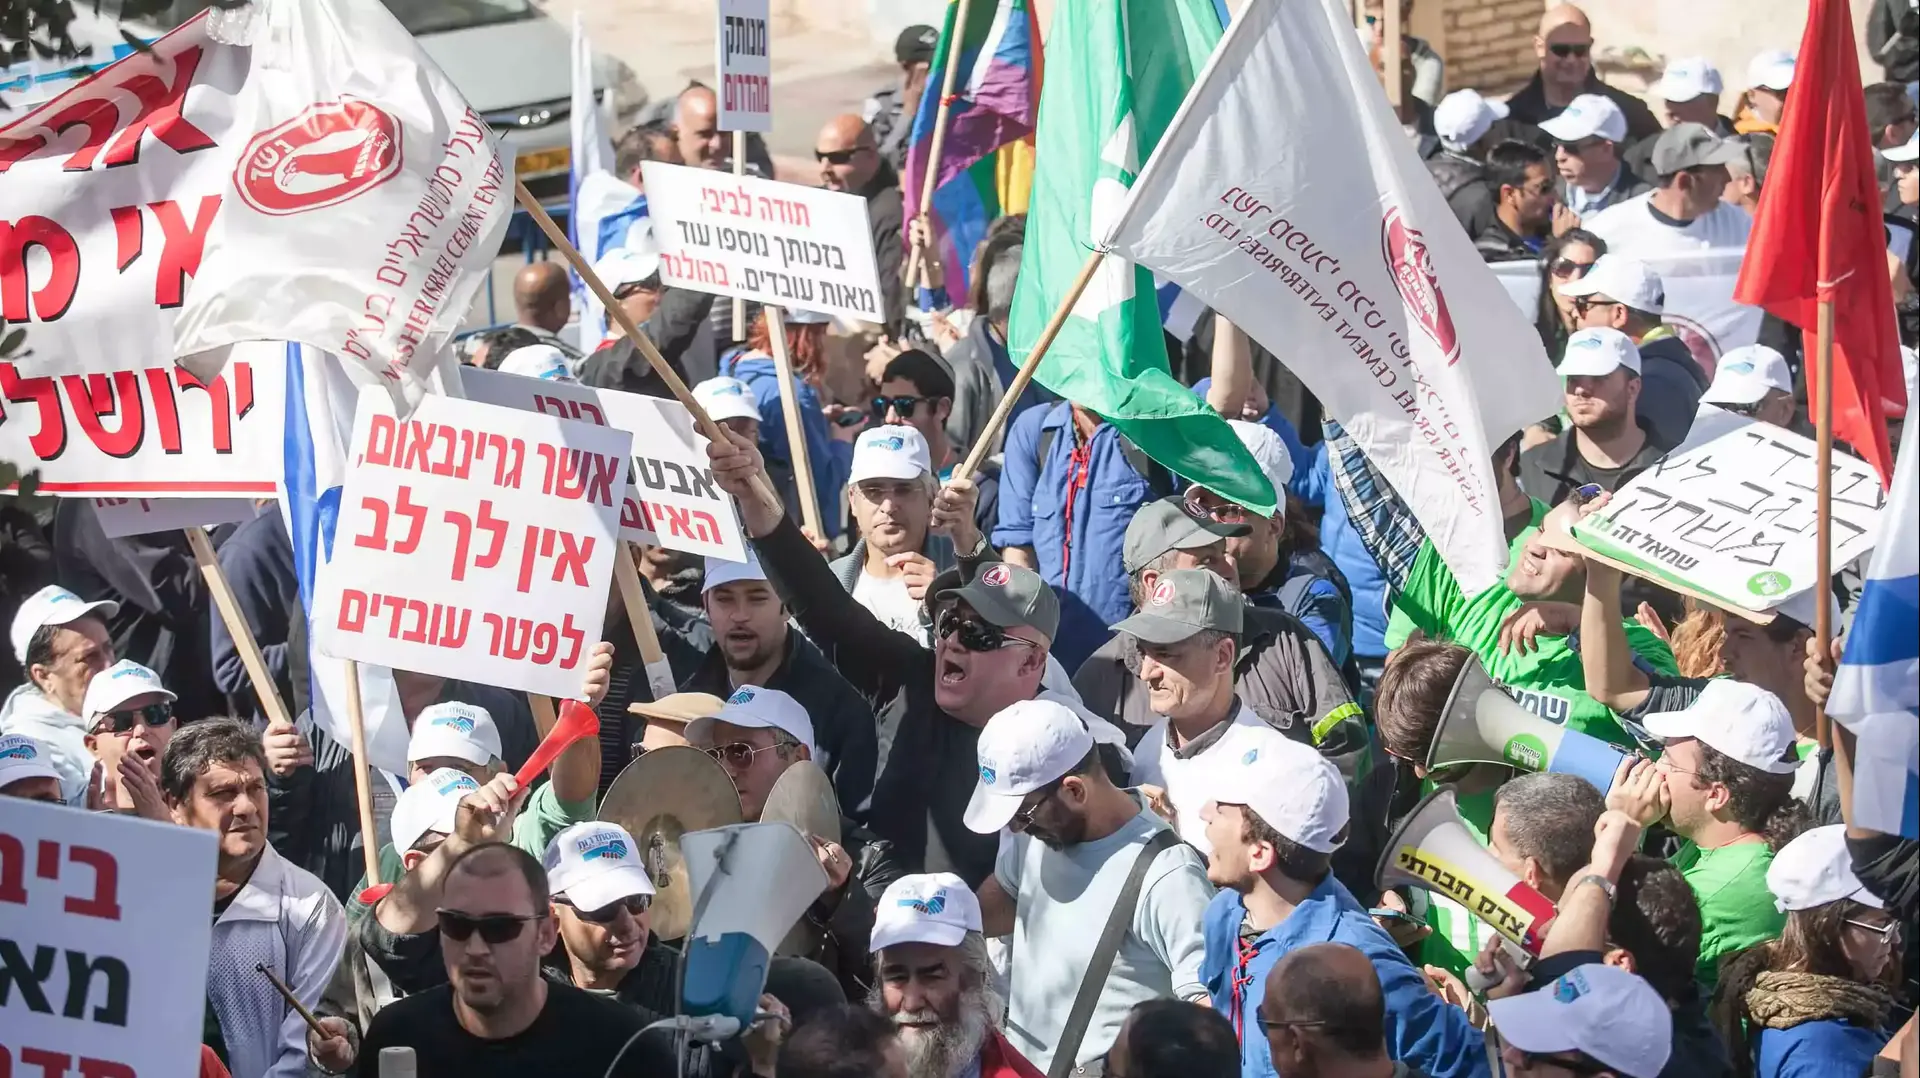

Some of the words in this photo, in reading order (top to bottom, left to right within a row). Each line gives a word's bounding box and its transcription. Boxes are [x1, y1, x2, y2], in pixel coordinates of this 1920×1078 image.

[725, 16, 766, 66] מנותק
[724, 74, 769, 113] מהדרום
[250, 139, 296, 182] נשר
[676, 220, 710, 247] עוד
[758, 196, 811, 227] תודה
[421, 254, 457, 302] ISRAEL
[446, 203, 488, 259] CEMENT
[716, 226, 770, 257] נוספו
[774, 236, 846, 270] בזכותך
[659, 249, 730, 286] בהולנד
[820, 281, 876, 313] מאות
[0, 362, 254, 461] ירושל
[357, 413, 526, 490] גרינבאום,
[537, 442, 619, 507] אשר
[627, 455, 721, 501] אבט
[354, 485, 428, 556] לב
[444, 499, 510, 582] לך
[620, 496, 723, 545] האיום
[1611, 524, 1643, 544] זה
[516, 526, 596, 594] אין
[1637, 533, 1700, 571] שמאל
[337, 588, 472, 650] עובדים
[483, 612, 586, 670] לפטר
[1400, 852, 1475, 901] חברתי
[1477, 896, 1526, 938] צדק
